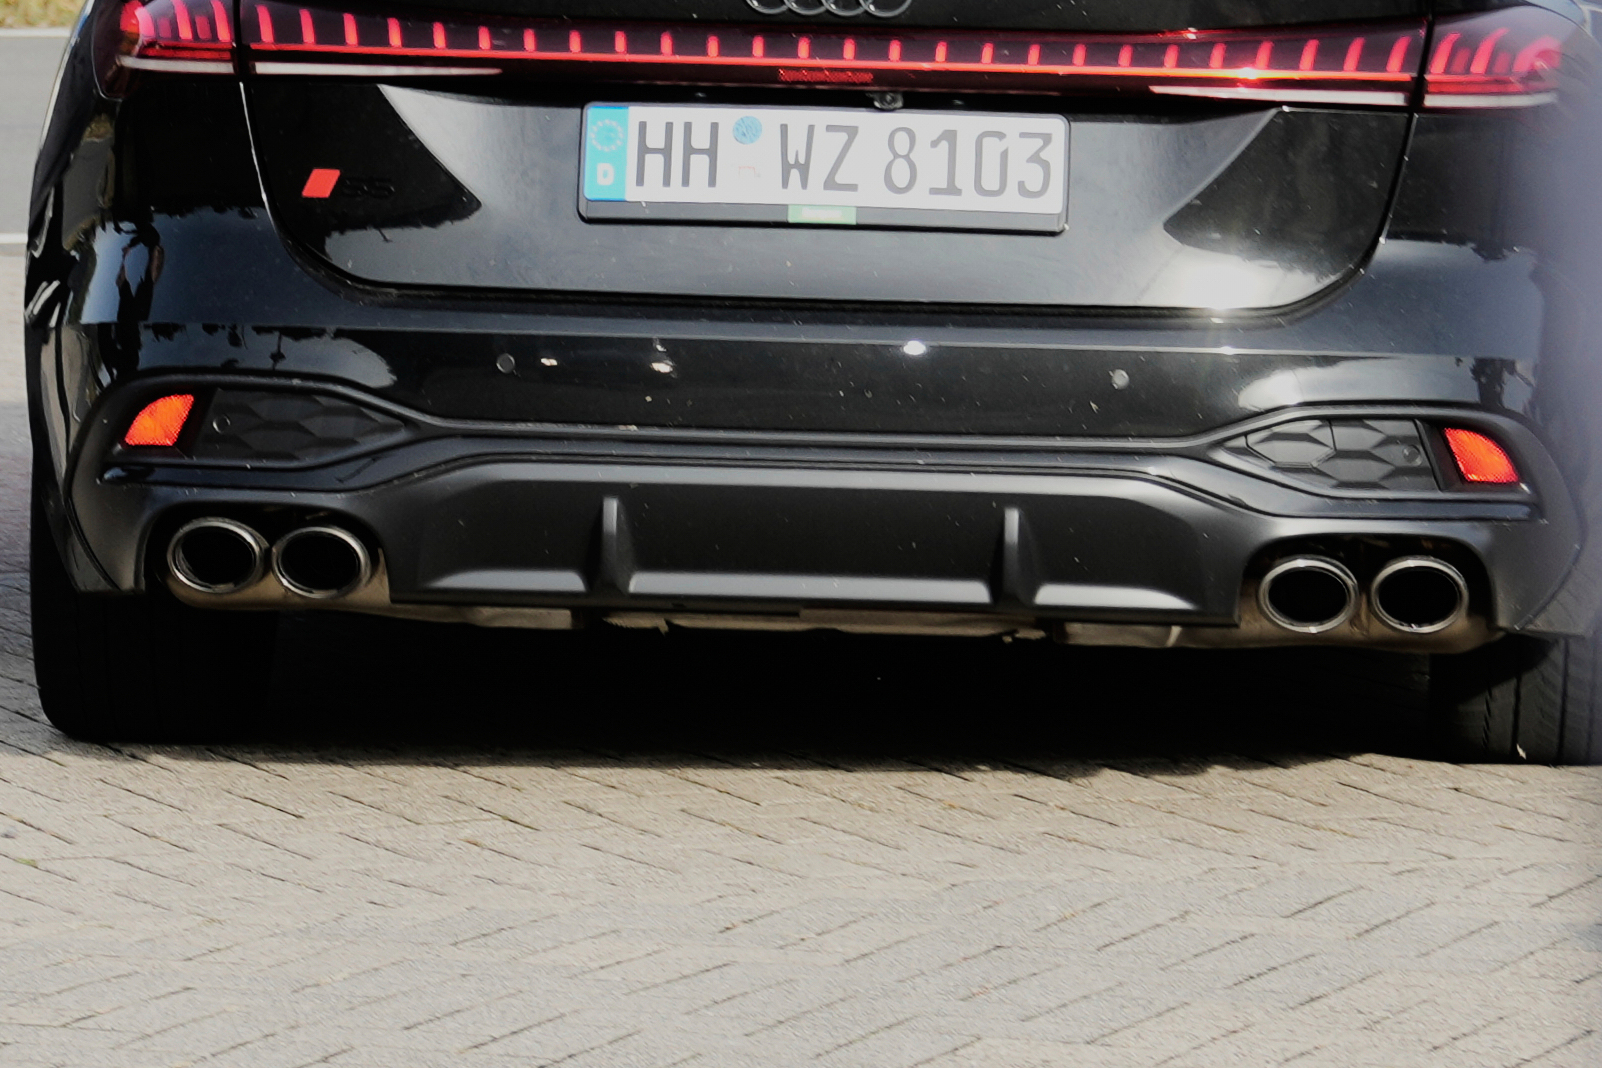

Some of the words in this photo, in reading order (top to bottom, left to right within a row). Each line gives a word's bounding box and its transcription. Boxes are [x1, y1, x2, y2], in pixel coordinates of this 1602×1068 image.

[596, 162, 616, 187] D
[634, 120, 720, 188] HH
[779, 122, 860, 193] WZ
[883, 126, 1054, 200] 8103
